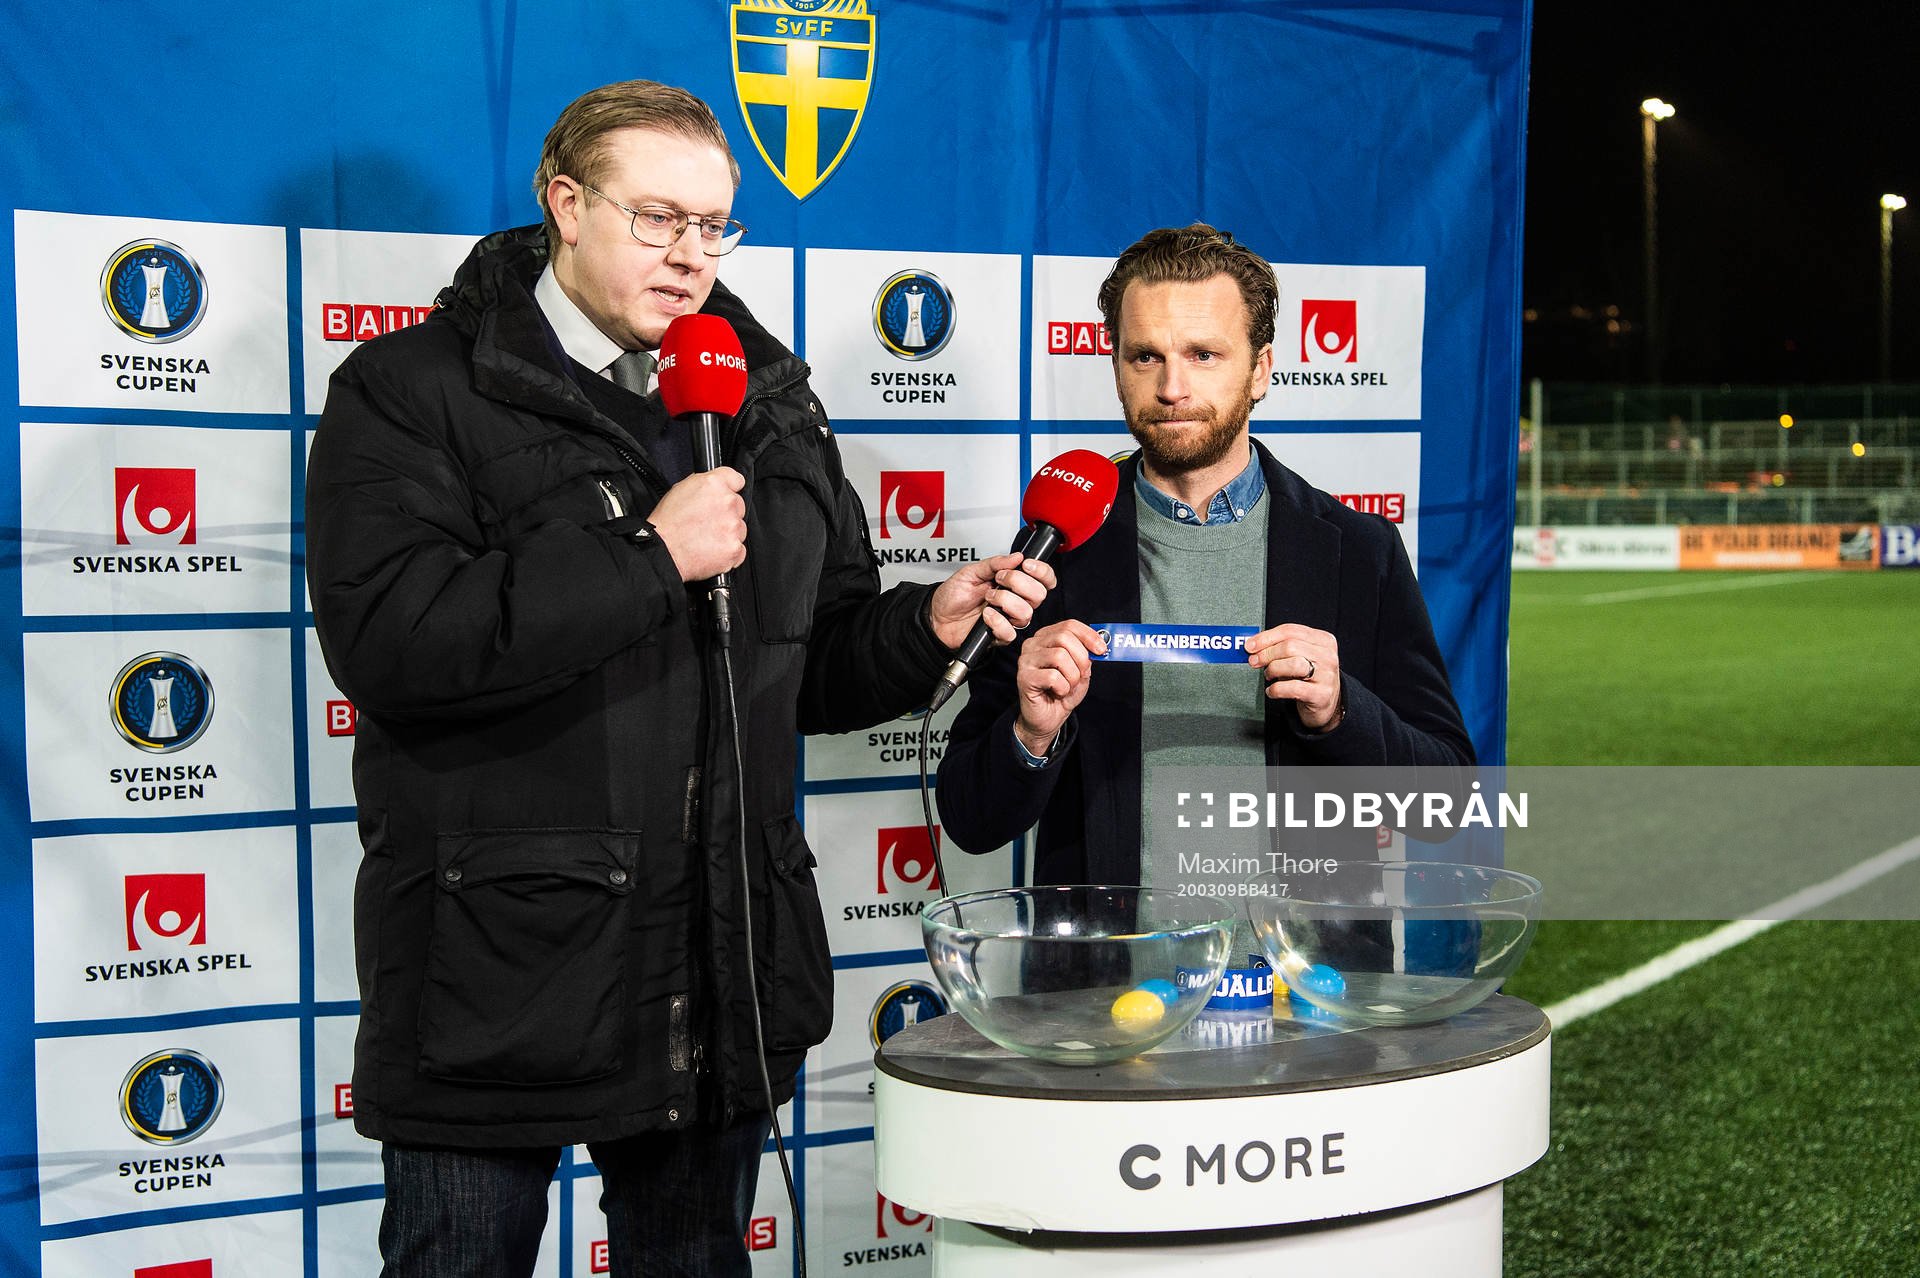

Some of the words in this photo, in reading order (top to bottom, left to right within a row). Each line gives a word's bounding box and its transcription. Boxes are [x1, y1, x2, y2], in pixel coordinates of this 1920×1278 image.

[775, 17, 833, 37] SvFF
[101, 355, 210, 374] SVENSKA
[658, 354, 676, 371] ORE
[700, 351, 712, 365] C
[716, 353, 747, 371] MORE
[116, 375, 196, 392] CUPEN
[871, 373, 957, 386] SVENSKA
[1271, 372, 1345, 386] SVENSKA
[1351, 372, 1388, 386] SPEL
[883, 390, 945, 403] CUPEN
[1040, 466, 1052, 476] C
[1051, 468, 1094, 492] MORE
[74, 556, 180, 573] SVENSKA
[187, 556, 242, 572] SPEL
[873, 549, 931, 563] NSKA
[937, 548, 980, 562] SPEL
[1114, 634, 1231, 649] FALKENBERGS
[868, 730, 950, 746] SVENKA
[110, 765, 217, 783] SVENSKA
[125, 784, 204, 801] CUPEN
[843, 901, 925, 921] SVENSKA
[86, 957, 190, 981] SVENSKA
[197, 954, 252, 973] SPEL
[119, 1154, 225, 1177] SVENSKA
[1119, 1144, 1161, 1190] C
[1186, 1132, 1345, 1186] MORE
[134, 1172, 212, 1193] CUPEN
[843, 1242, 926, 1267] SVENSKA
